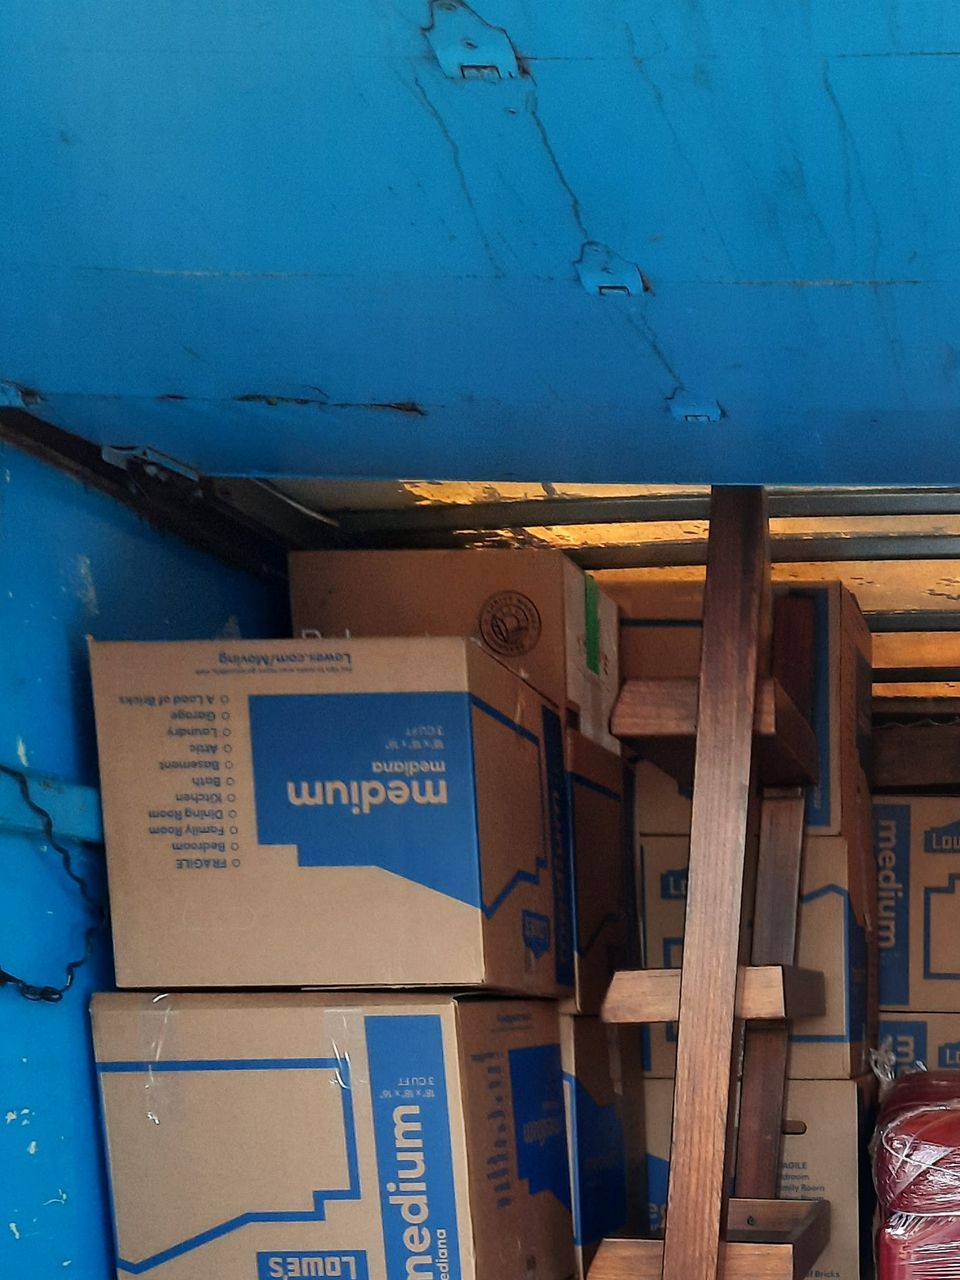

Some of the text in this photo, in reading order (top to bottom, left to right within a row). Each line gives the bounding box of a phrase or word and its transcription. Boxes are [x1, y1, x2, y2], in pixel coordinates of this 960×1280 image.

[218, 652, 352, 666] Lowes.com/Moving
[159, 696, 170, 706] of
[173, 695, 203, 705] Load
[170, 710, 216, 721] Garage
[167, 727, 217, 738] Laundry
[190, 744, 218, 754] Attic
[159, 760, 220, 770] Basement
[372, 760, 445, 776] mediana
[192, 777, 221, 787] Bath
[176, 793, 222, 803] Kitchen
[287, 780, 448, 815] medium
[148, 808, 223, 820] Dining Room
[148, 825, 224, 837] Family Room
[172, 842, 225, 852] Bedroom
[176, 858, 227, 869] FRAGILE
[878, 819, 903, 948] medium
[399, 1077, 434, 1085] 3 CU FT
[268, 1256, 357, 1280] LOWE'S
[815, 1270, 840, 1278] Bricks
